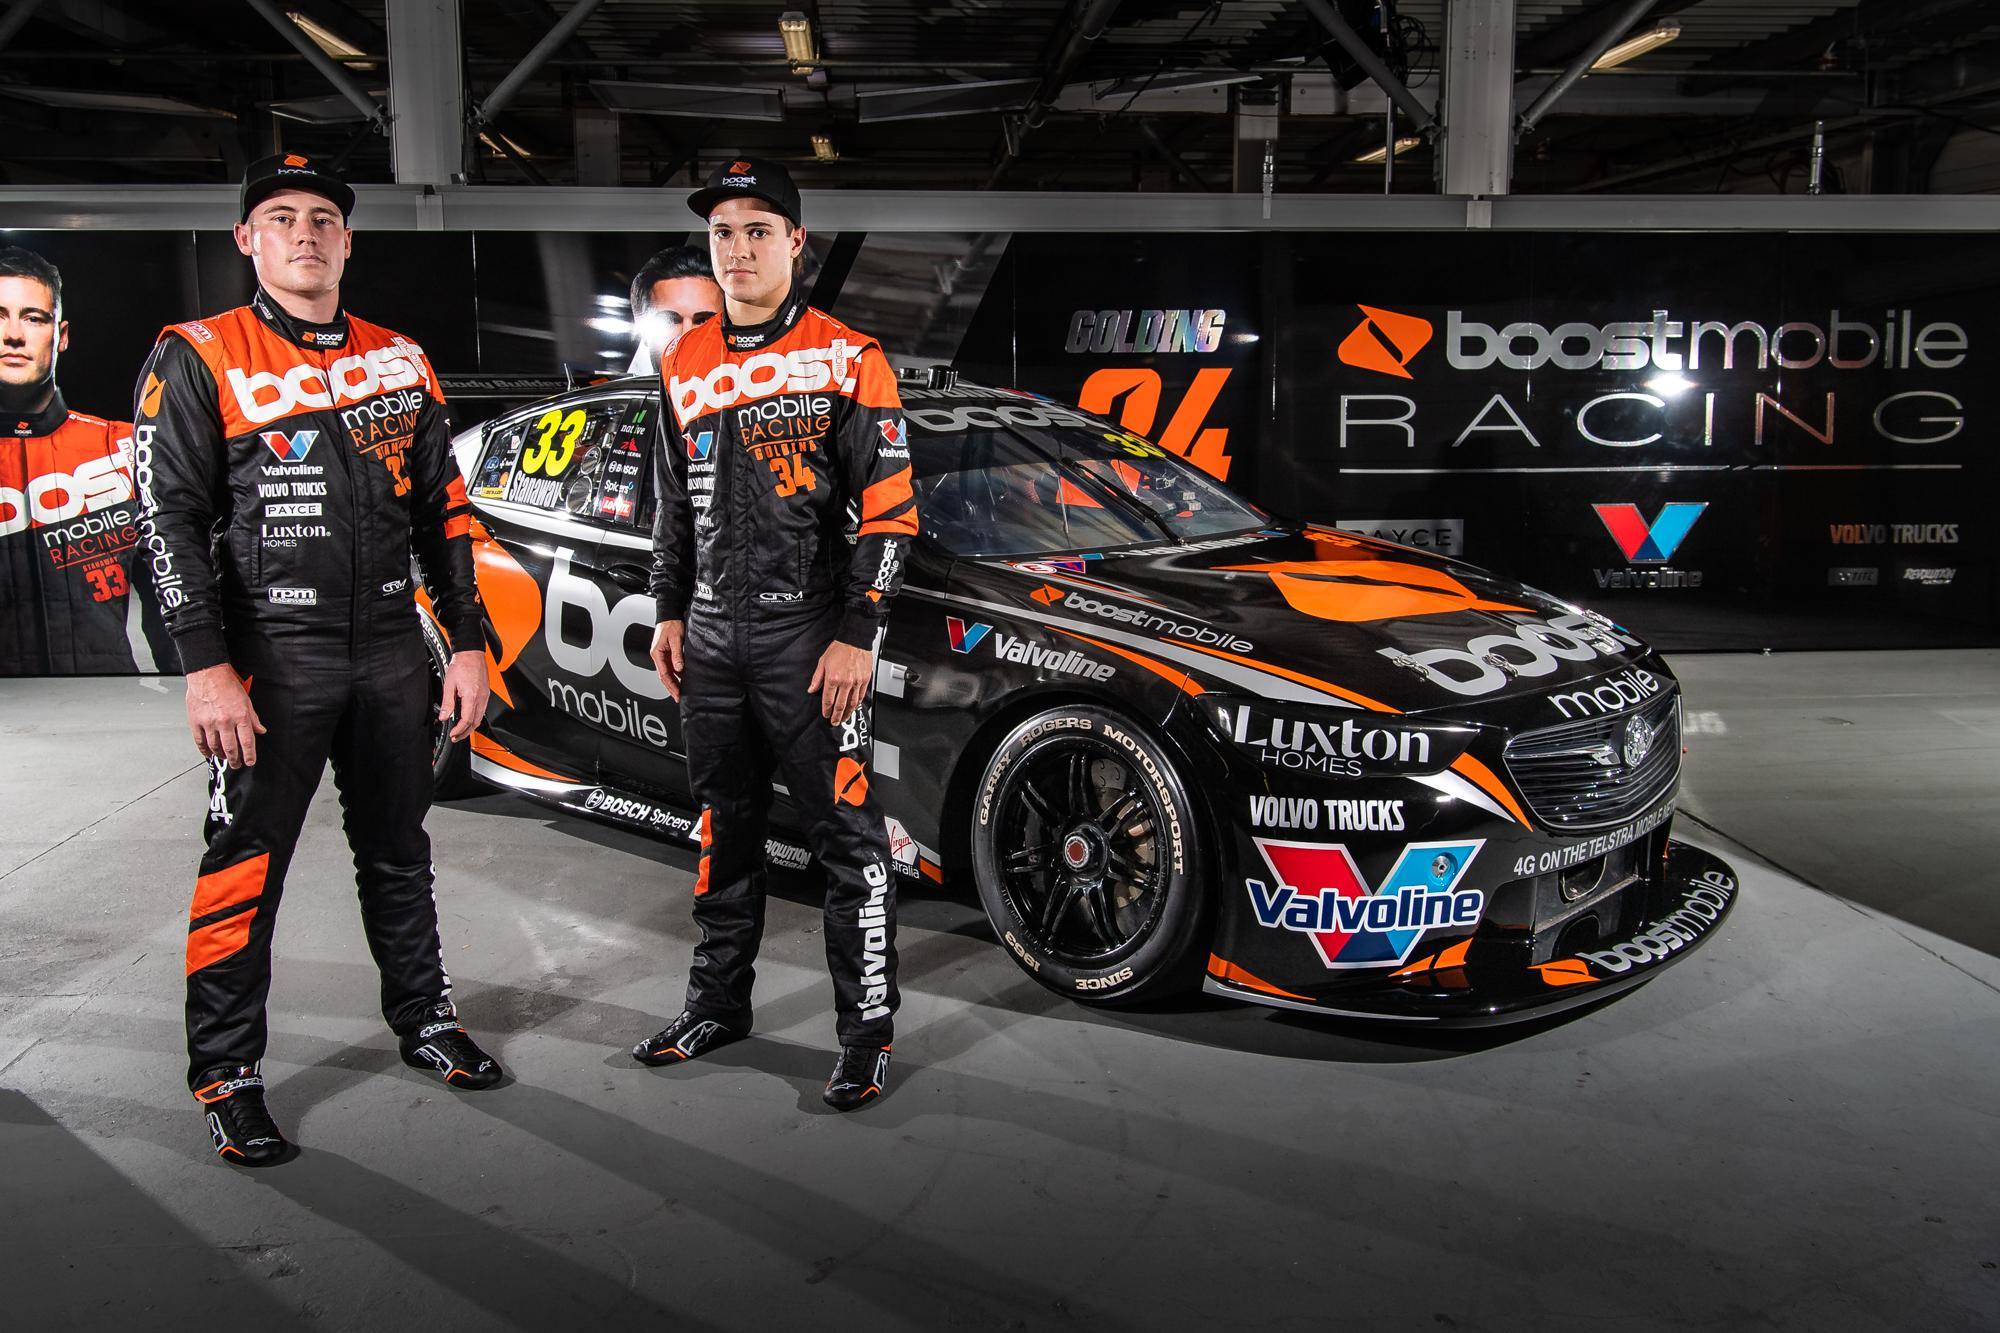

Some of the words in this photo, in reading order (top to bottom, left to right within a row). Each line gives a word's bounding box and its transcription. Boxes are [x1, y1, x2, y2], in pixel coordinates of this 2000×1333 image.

[722, 176, 757, 185] boost
[737, 334, 765, 343] boost
[1065, 309, 1226, 353] GOLDING
[1447, 309, 1968, 371] boostmobile
[226, 344, 432, 424] boost
[670, 346, 863, 426] boost
[341, 391, 423, 430] mobile
[738, 394, 832, 428] mobile
[741, 415, 831, 446] RACING
[1340, 391, 1964, 448] RACING
[522, 408, 588, 477] 33
[258, 483, 289, 498] VOLVO
[291, 482, 327, 496] TRUCKS
[261, 465, 324, 476] Valvoline
[769, 453, 817, 498] 34
[43, 510, 132, 548] mobile
[268, 505, 317, 515] PAYCE
[49, 526, 139, 563] RACING
[1830, 524, 1887, 545] VOLVO
[1891, 524, 1960, 545] TRUCKS
[85, 563, 130, 602] 33
[872, 539, 898, 591] boost
[1592, 568, 1704, 589] Valvoline
[272, 589, 314, 599] rpm
[1064, 592, 1253, 653] boostmobile
[995, 633, 1116, 681] Valvoline
[547, 678, 668, 748] mobile
[1547, 669, 1660, 719] mobile
[1234, 704, 1430, 763] Luxton
[1261, 748, 1362, 777] HOMES
[599, 794, 651, 821] BOSCH
[649, 808, 692, 831] Spicers
[980, 751, 1012, 825] GARRY
[1018, 717, 1093, 748] ROGERS
[1103, 724, 1184, 875] MOTORSPORT
[1250, 795, 1318, 828] VOLVO
[1323, 799, 1405, 831] TRUCKS
[888, 825, 912, 860] Virgin
[1513, 856, 1536, 876] 4G
[1539, 850, 1561, 872] ON
[1563, 841, 1588, 867] THE
[1588, 824, 1633, 859] TELSTRA
[1245, 878, 1484, 933] Valvoline
[1575, 871, 1734, 972] boostmobile
[857, 862, 892, 1021] Valvoline
[1004, 930, 1041, 973] 1963
[1075, 966, 1134, 990] SINCE
